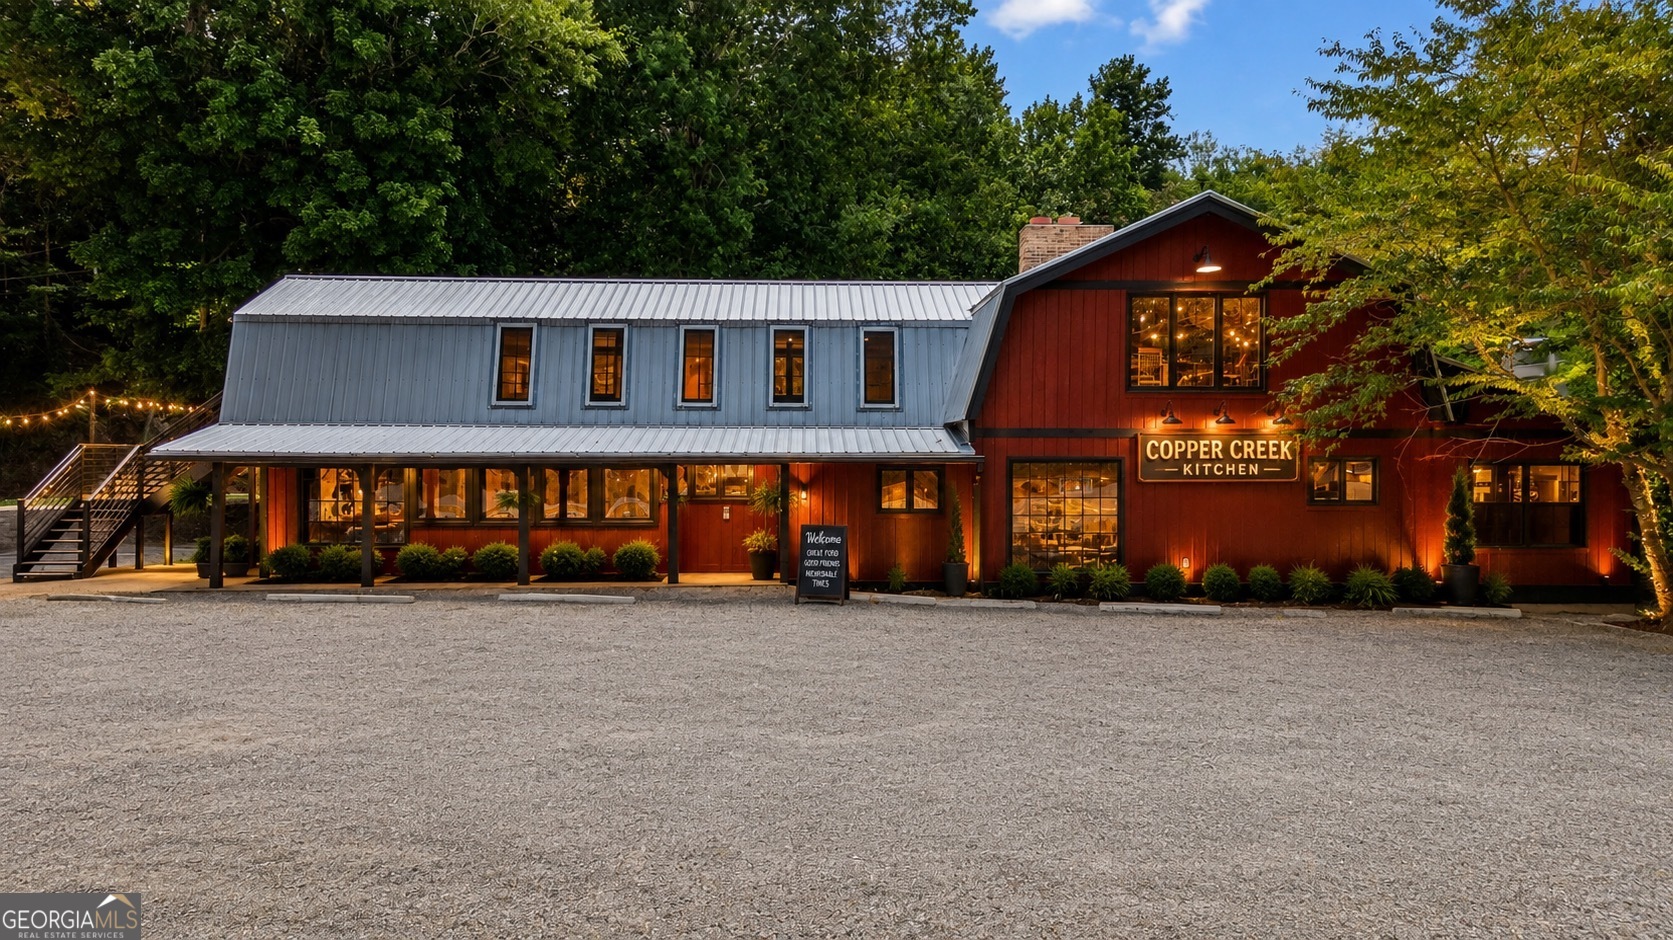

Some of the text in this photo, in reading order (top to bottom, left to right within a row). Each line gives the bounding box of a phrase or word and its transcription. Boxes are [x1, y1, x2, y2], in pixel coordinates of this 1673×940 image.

[1146, 439, 1293, 460] COPPER CREEK
[1183, 463, 1259, 476] KITCHEN
[805, 530, 842, 544] Welcome
